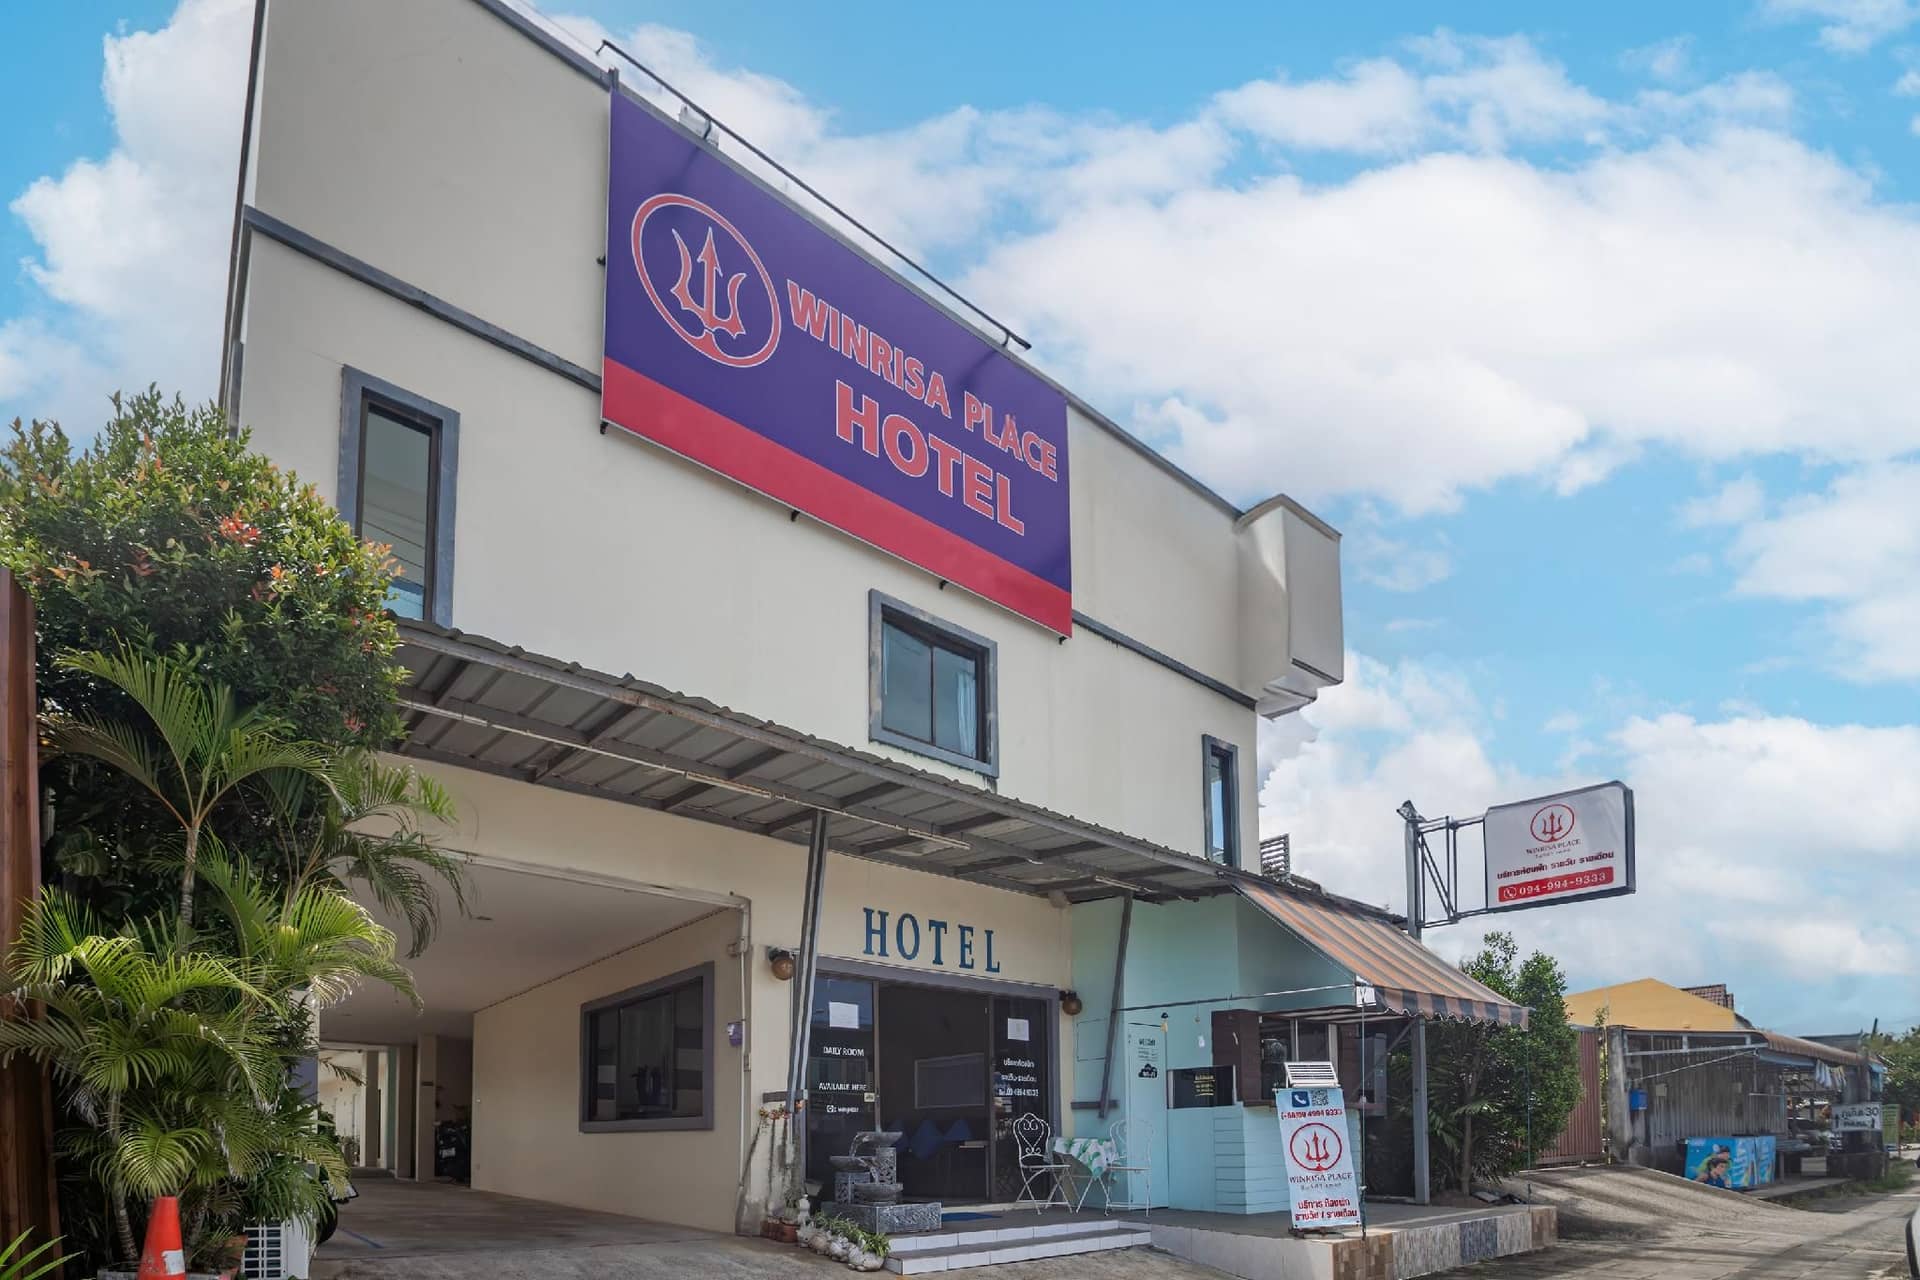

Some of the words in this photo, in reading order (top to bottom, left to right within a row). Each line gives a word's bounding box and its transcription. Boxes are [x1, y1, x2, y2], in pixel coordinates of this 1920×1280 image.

[787, 279, 952, 419] WINRISA
[964, 390, 1058, 482] PLACE
[835, 379, 1025, 536] HOTEL
[1558, 838, 1581, 850] PLACE
[1519, 872, 1606, 895] 094-994-9333
[863, 907, 1000, 973] HOTEL
[823, 1046, 842, 1055] DAILY
[842, 1047, 865, 1056] ROOM
[1327, 1172, 1353, 1182] PLACE
